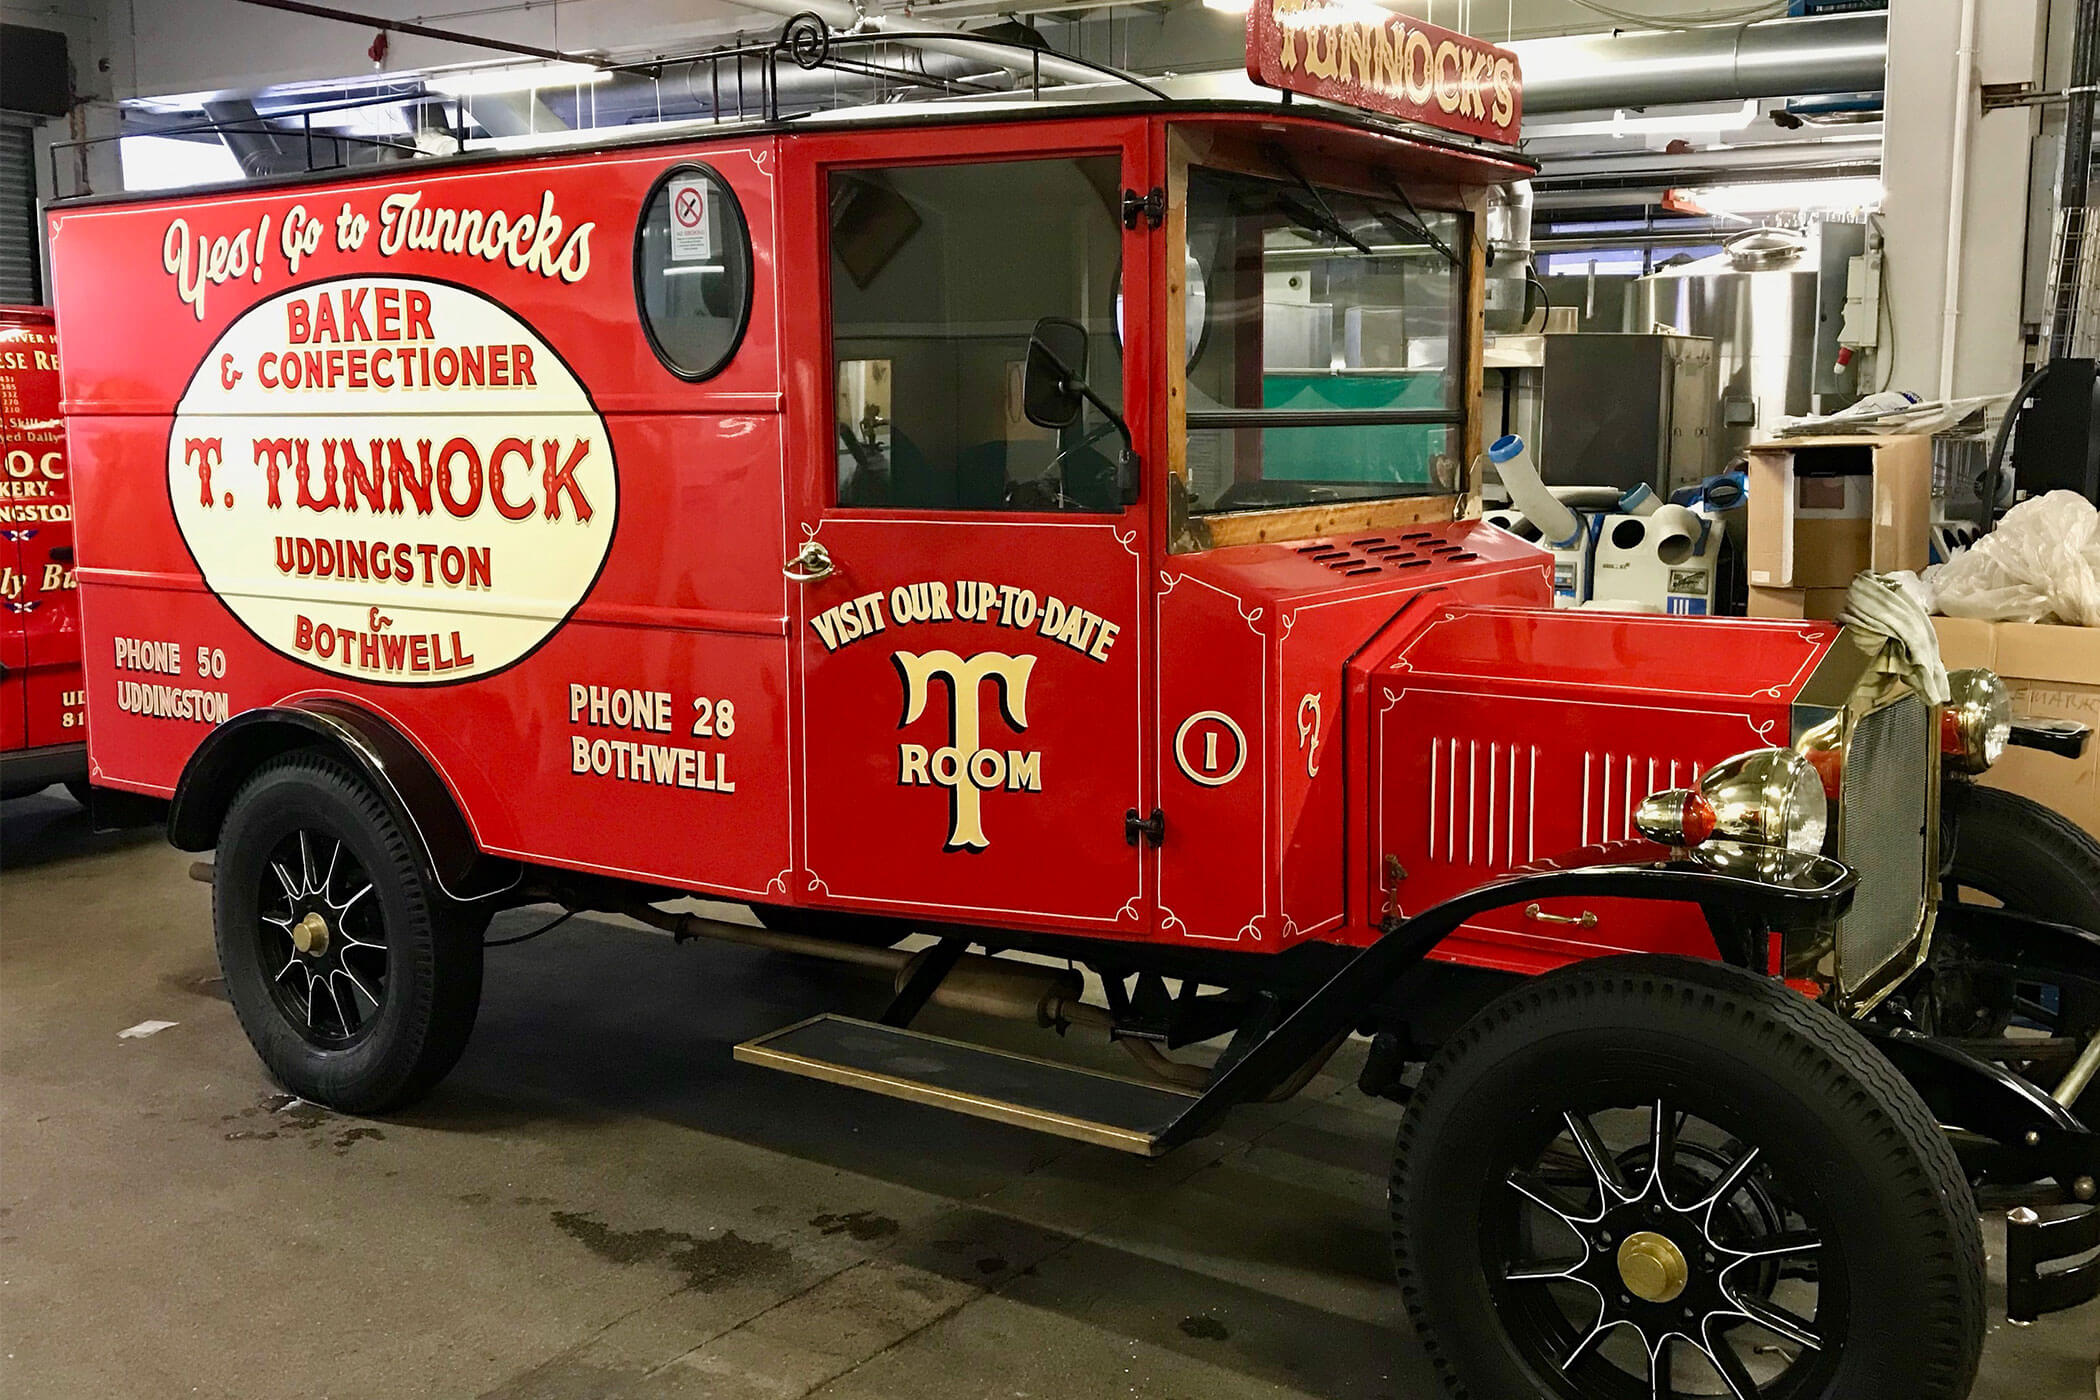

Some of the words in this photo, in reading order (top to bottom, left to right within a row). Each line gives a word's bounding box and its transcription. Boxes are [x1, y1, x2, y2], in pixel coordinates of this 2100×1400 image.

[1271, 0, 1514, 128] TUNNOCK'S
[163, 214, 271, 320] Yes!
[281, 204, 323, 274] Go
[336, 202, 369, 252] to
[379, 189, 596, 283] Tunnocks
[286, 287, 436, 346] BAKER
[221, 353, 243, 391] &
[257, 344, 538, 391] CONFECTIONER
[185, 437, 235, 510] T.
[252, 437, 595, 524] TUNNOCK
[275, 536, 492, 590] UDDINGSTON
[294, 614, 475, 673] BOTHWELL
[368, 606, 393, 632] &
[810, 591, 887, 651] VISIT
[891, 581, 954, 624] OUR
[957, 580, 1121, 663] UP-TO-DATE
[114, 636, 181, 675] PHONE
[198, 646, 227, 679] 50
[117, 680, 229, 724] UDDINGSTON
[569, 683, 672, 732] PHONE
[692, 696, 736, 738] 28
[571, 735, 736, 793] BOTHWELL
[893, 649, 1038, 850] T
[900, 743, 1042, 791] ROOM
